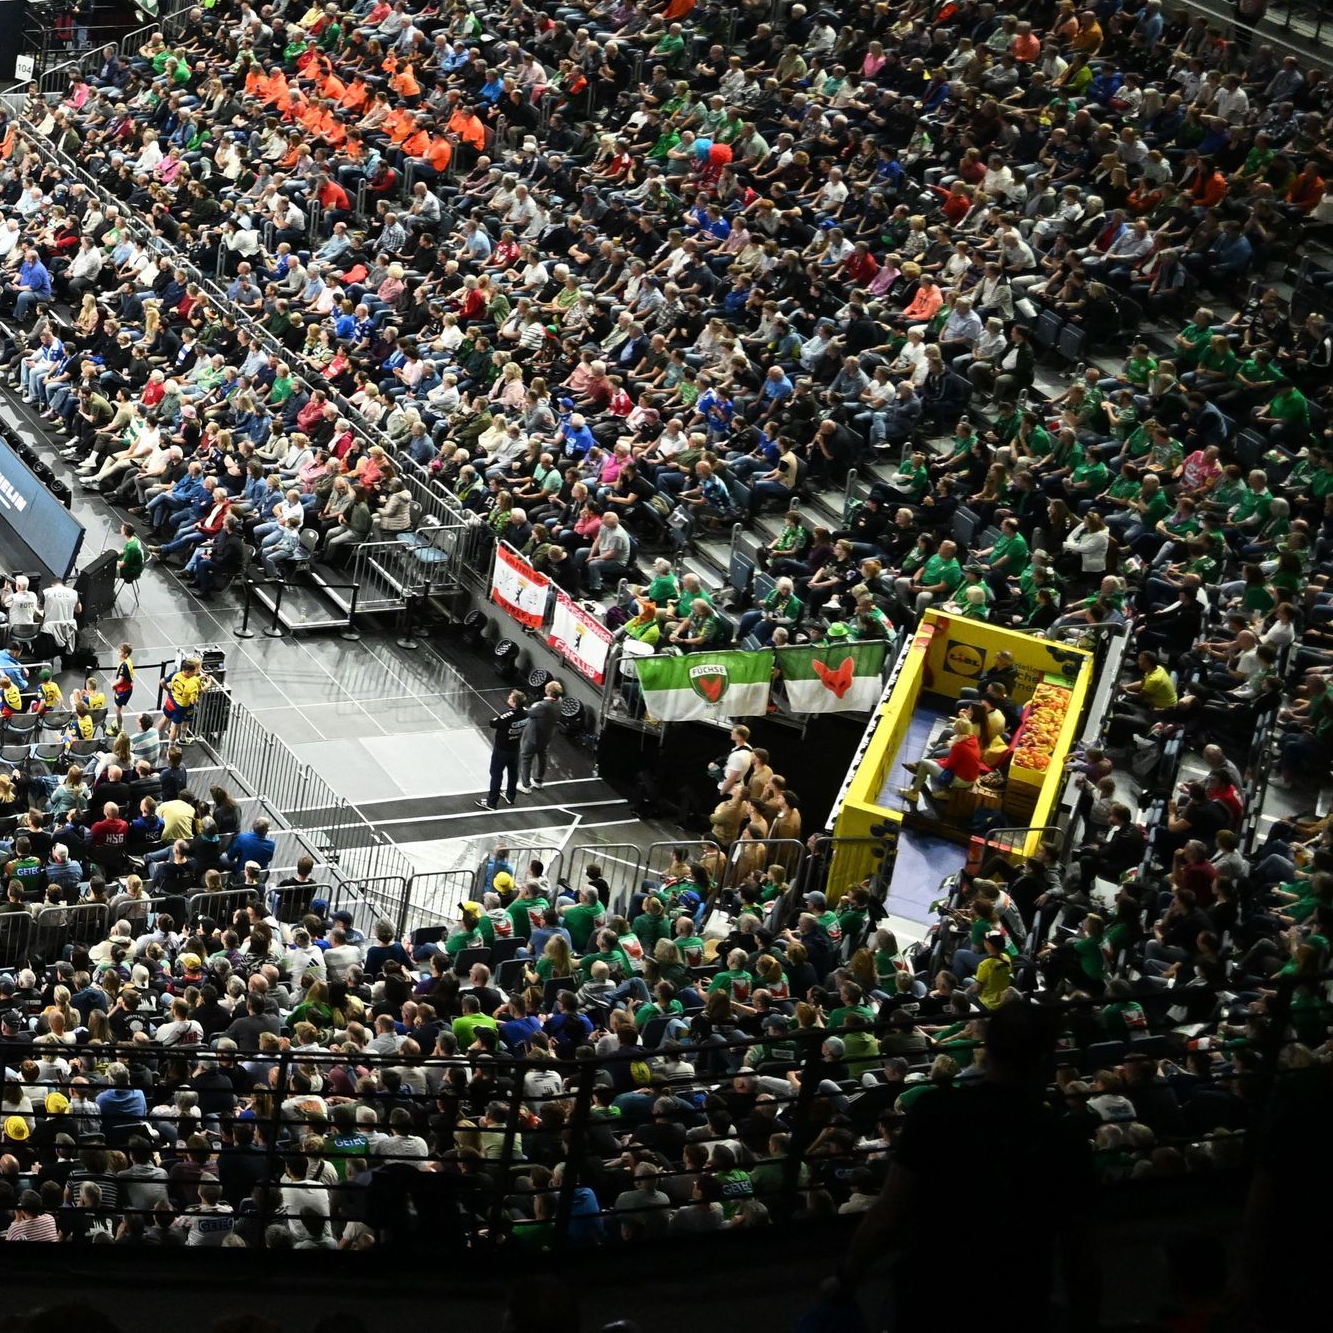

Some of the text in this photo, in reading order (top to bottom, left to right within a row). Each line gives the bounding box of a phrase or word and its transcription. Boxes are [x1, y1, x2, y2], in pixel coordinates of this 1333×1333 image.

[17, 63, 31, 74] 104
[949, 653, 980, 667] LIDL
[105, 833, 124, 844] HSG
[16, 866, 40, 877] GETEC
[334, 1137, 366, 1147] GETEC
